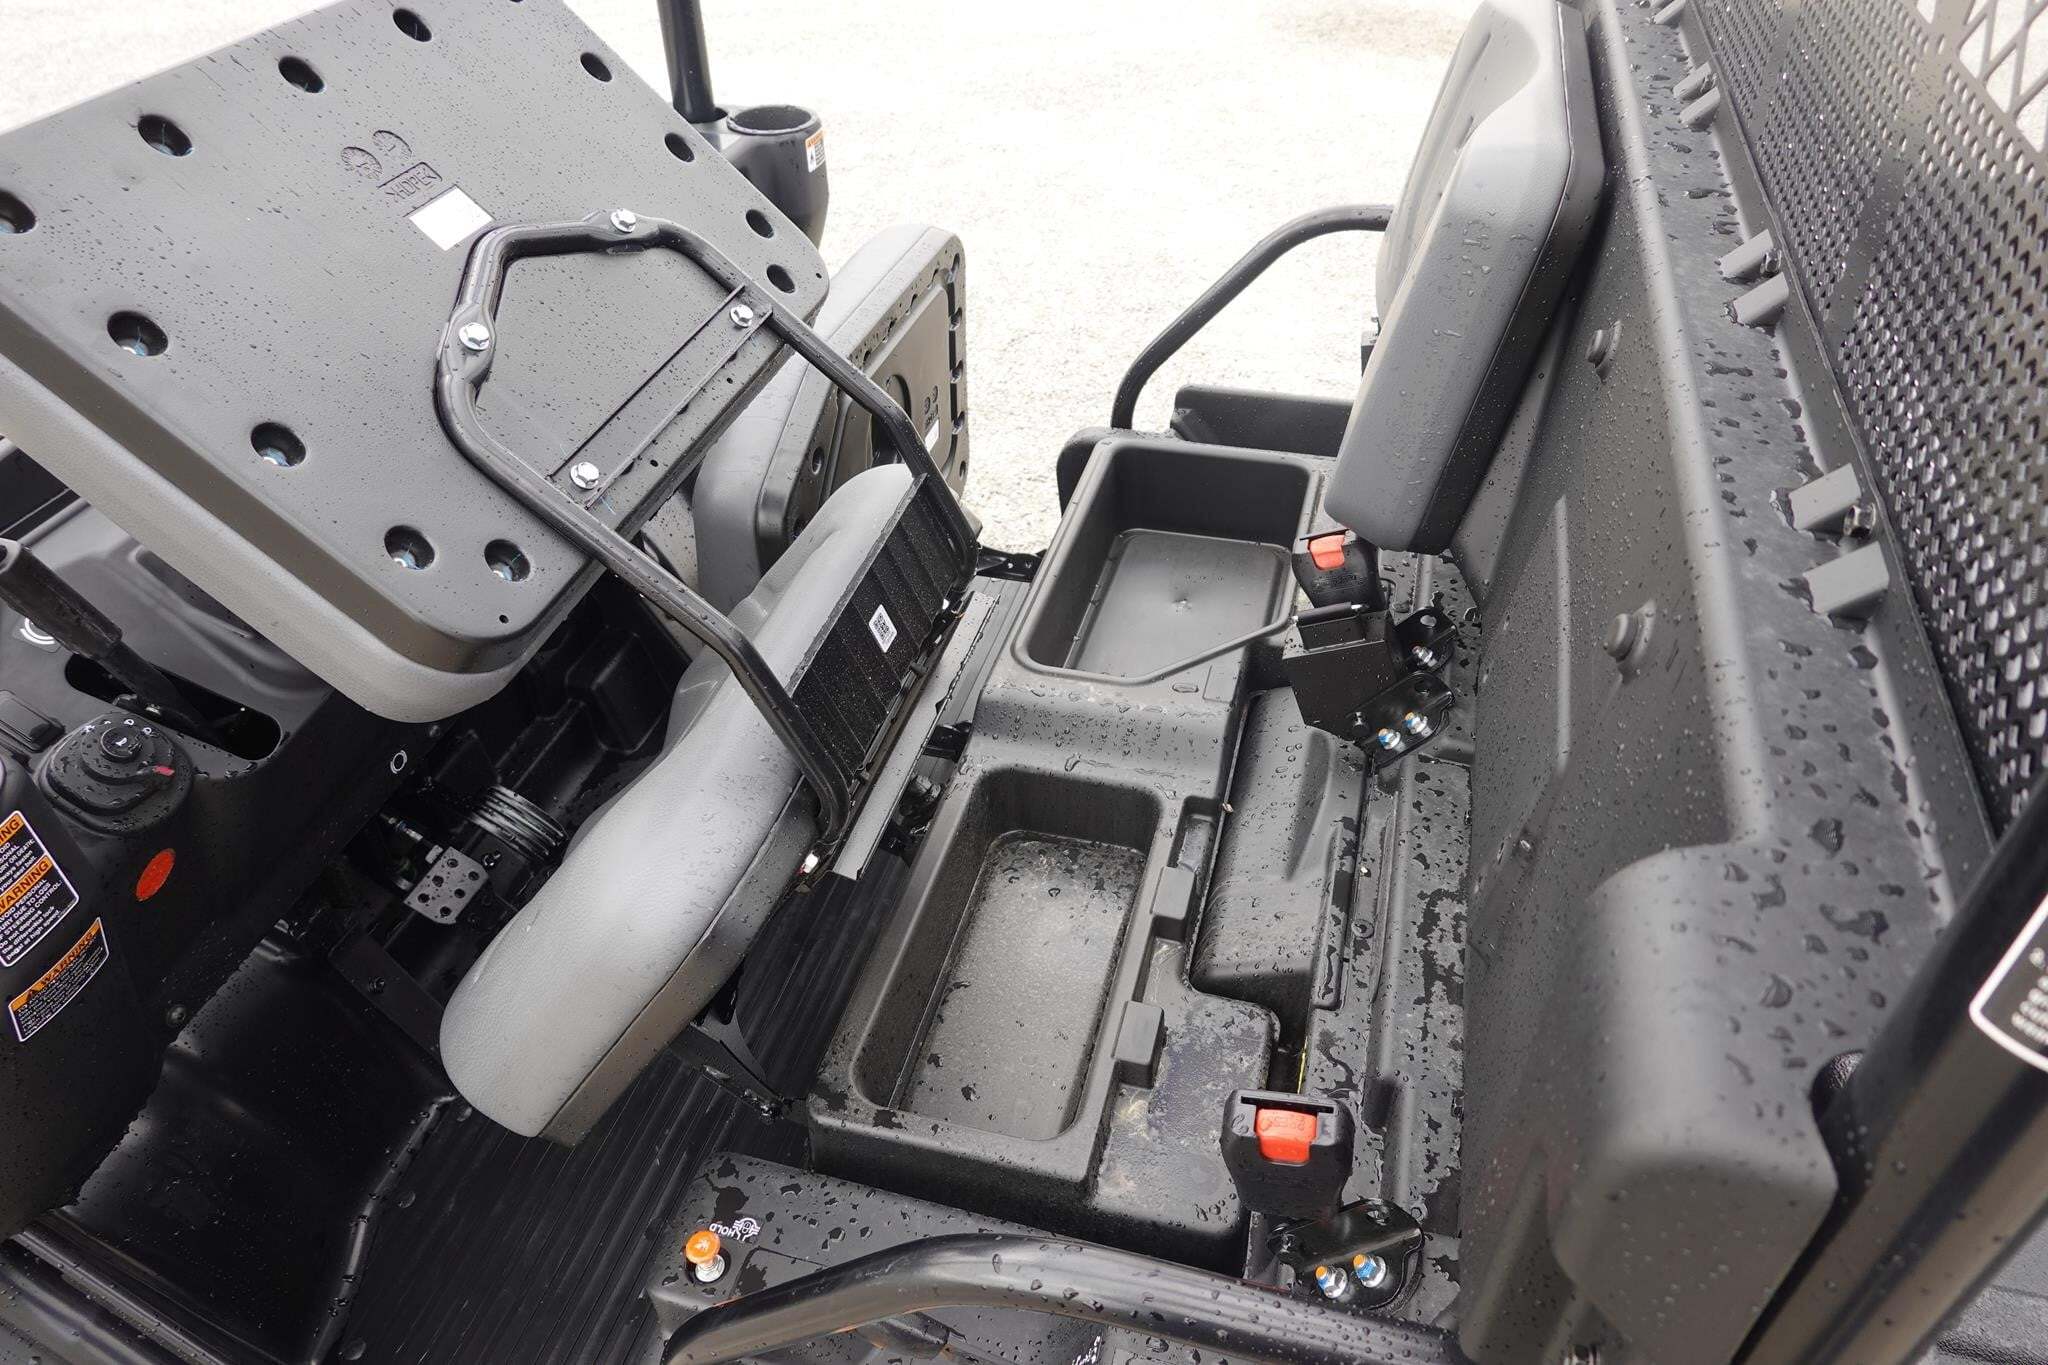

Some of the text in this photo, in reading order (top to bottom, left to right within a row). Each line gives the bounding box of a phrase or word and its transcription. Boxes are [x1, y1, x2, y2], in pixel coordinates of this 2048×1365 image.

[9, 855, 17, 864] OR
[16, 850, 32, 867] fasten
[0, 878, 14, 892] your
[13, 867, 25, 879] seat
[15, 878, 46, 908] PERSONAL
[4, 906, 35, 936] STEERING
[34, 880, 62, 908] CONTROL:
[13, 905, 27, 919] DUE
[26, 897, 35, 906] TO
[35, 882, 51, 899] LOSS
[2, 944, 13, 955] the
[13, 916, 43, 945] differential
[42, 906, 55, 918] lock
[8, 930, 19, 941] not
[18, 910, 41, 933] depress
[6, 943, 24, 960] pedal
[30, 926, 44, 940] high
[41, 932, 94, 986] WARNING
[709, 1223, 736, 1237] HOLD
